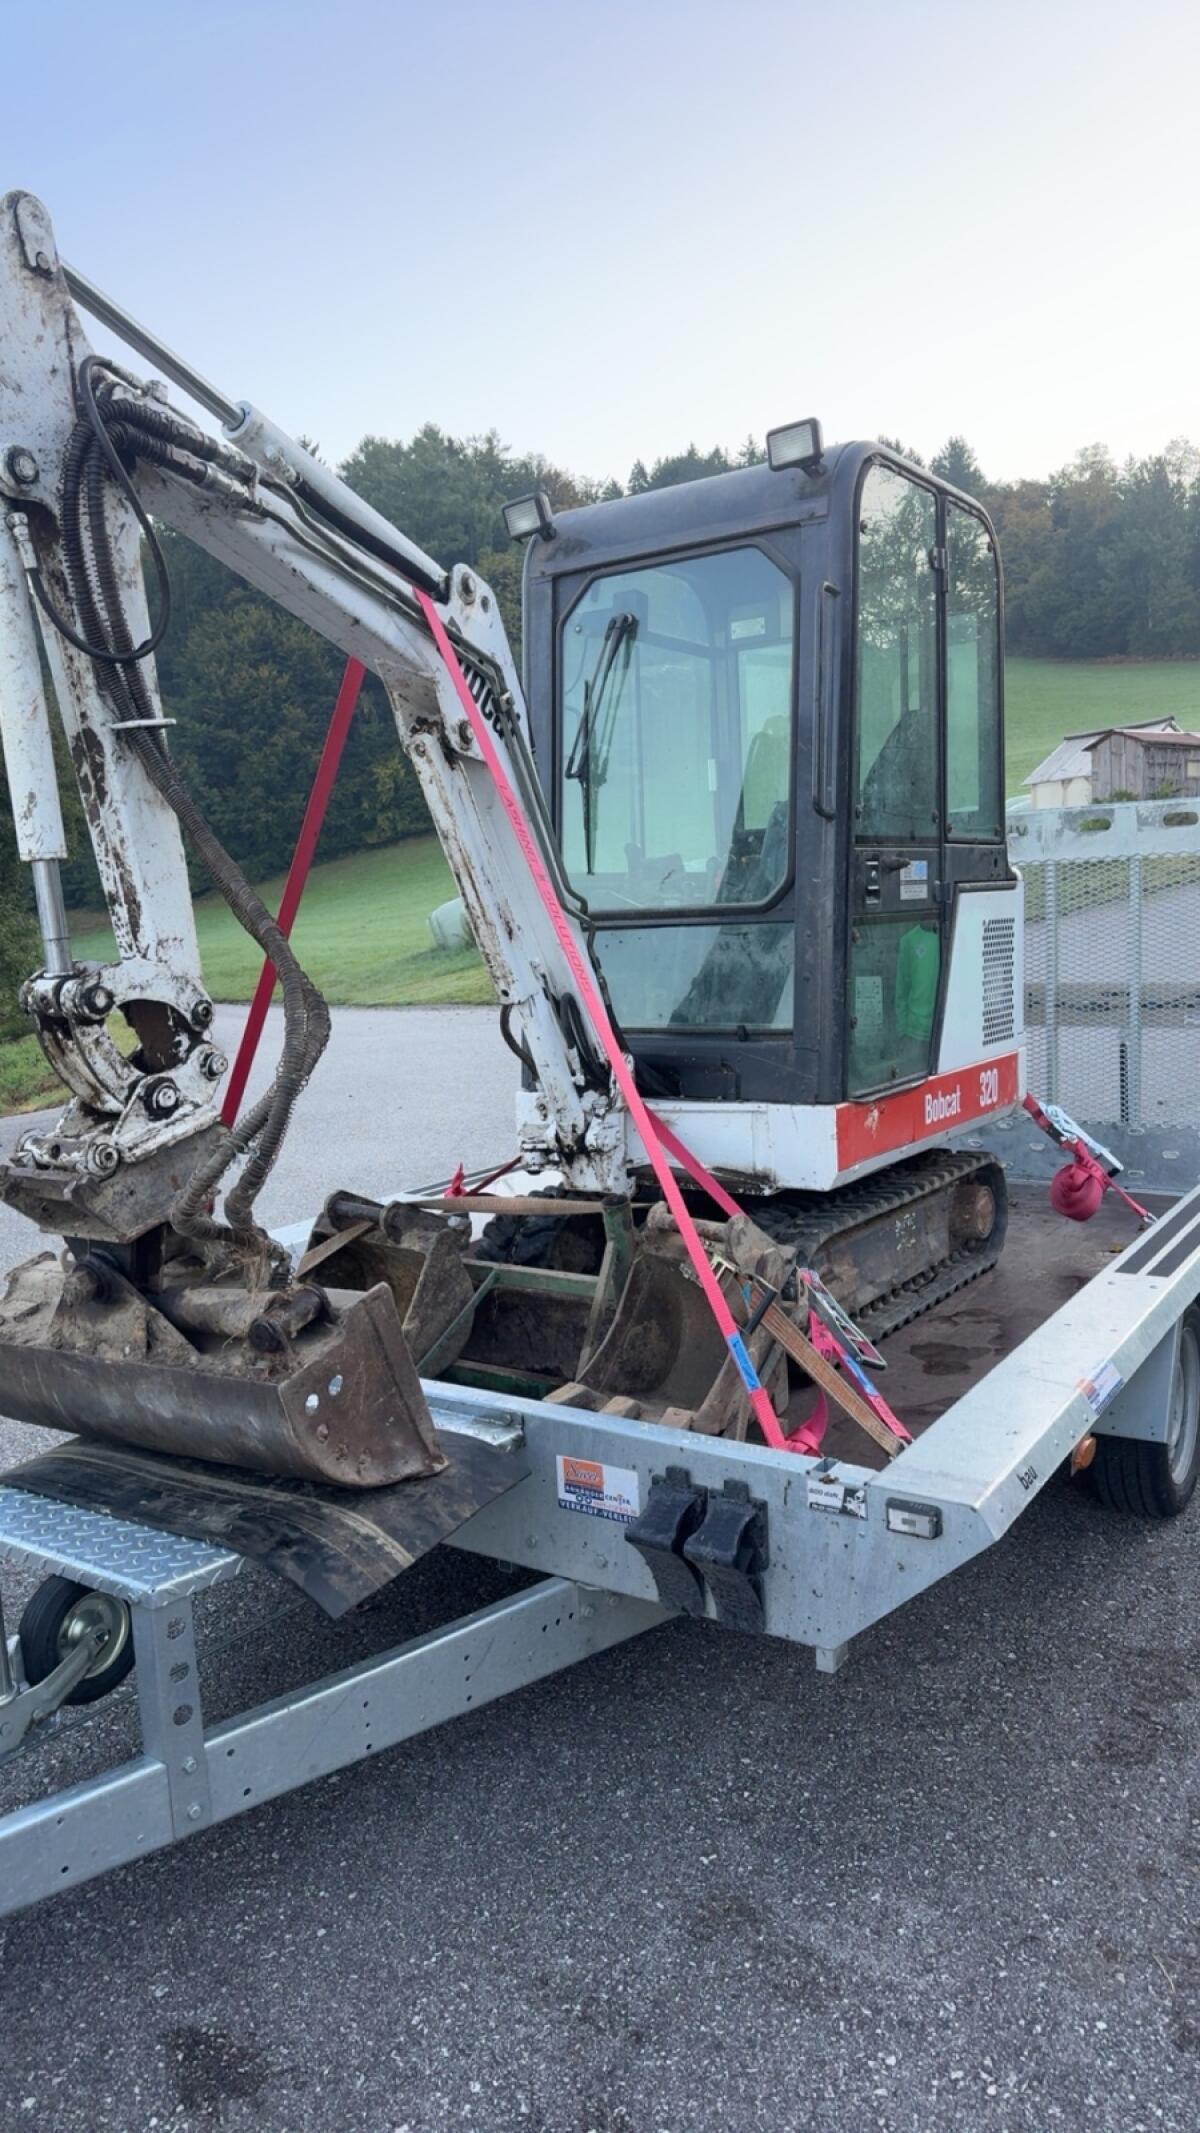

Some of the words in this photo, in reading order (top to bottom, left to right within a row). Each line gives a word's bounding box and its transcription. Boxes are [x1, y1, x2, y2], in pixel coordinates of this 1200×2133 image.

[925, 1084, 961, 1125] Bobcat
[979, 1068, 998, 1107] 320
[1016, 1464, 1038, 1490] bau
